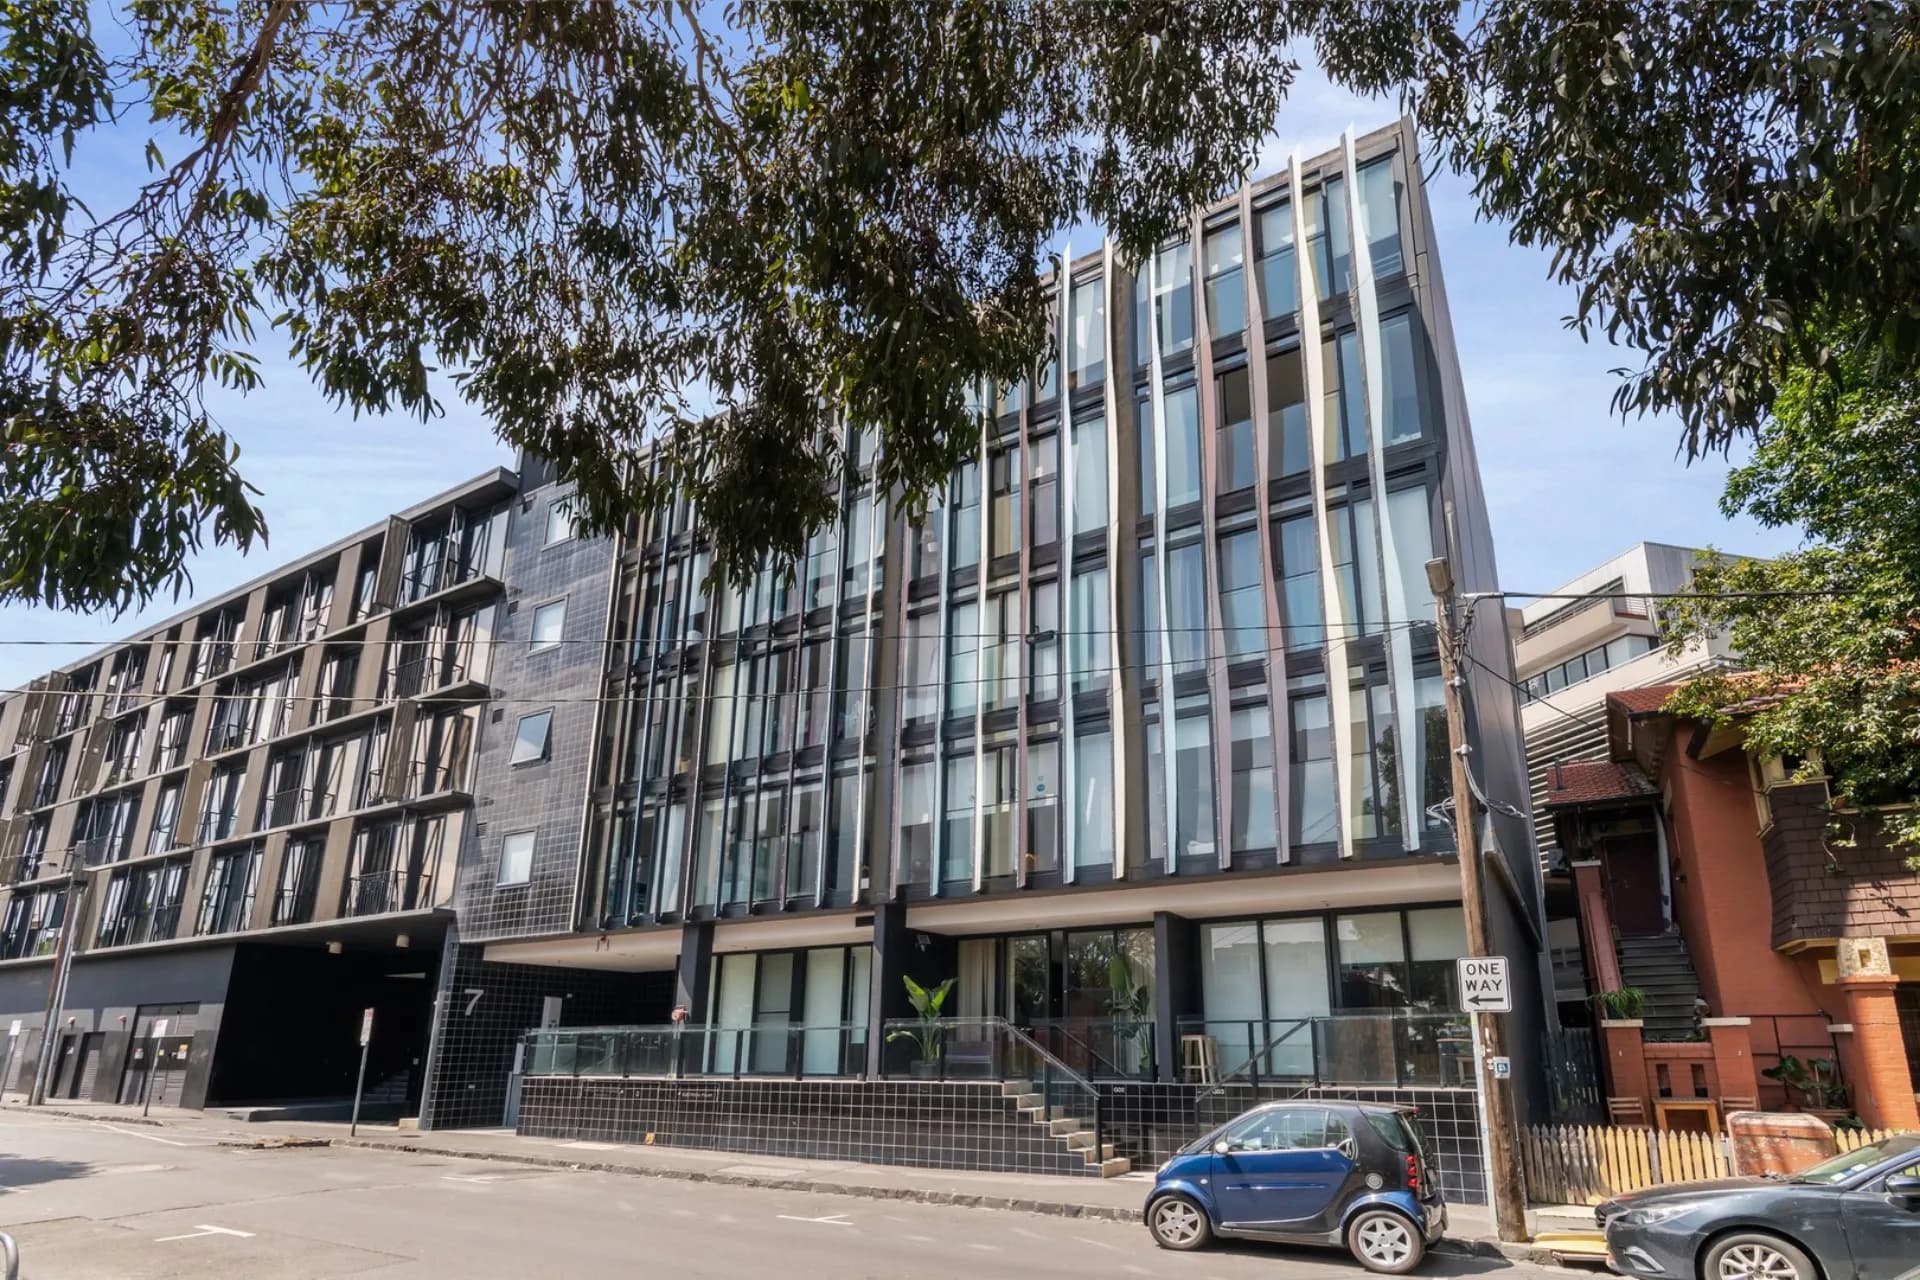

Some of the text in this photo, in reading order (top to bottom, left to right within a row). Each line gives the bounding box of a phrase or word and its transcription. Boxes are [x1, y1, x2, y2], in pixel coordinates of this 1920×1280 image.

[1466, 962, 1500, 976] ONE
[1465, 979, 1502, 992] WAY
[465, 989, 484, 1016] 7
